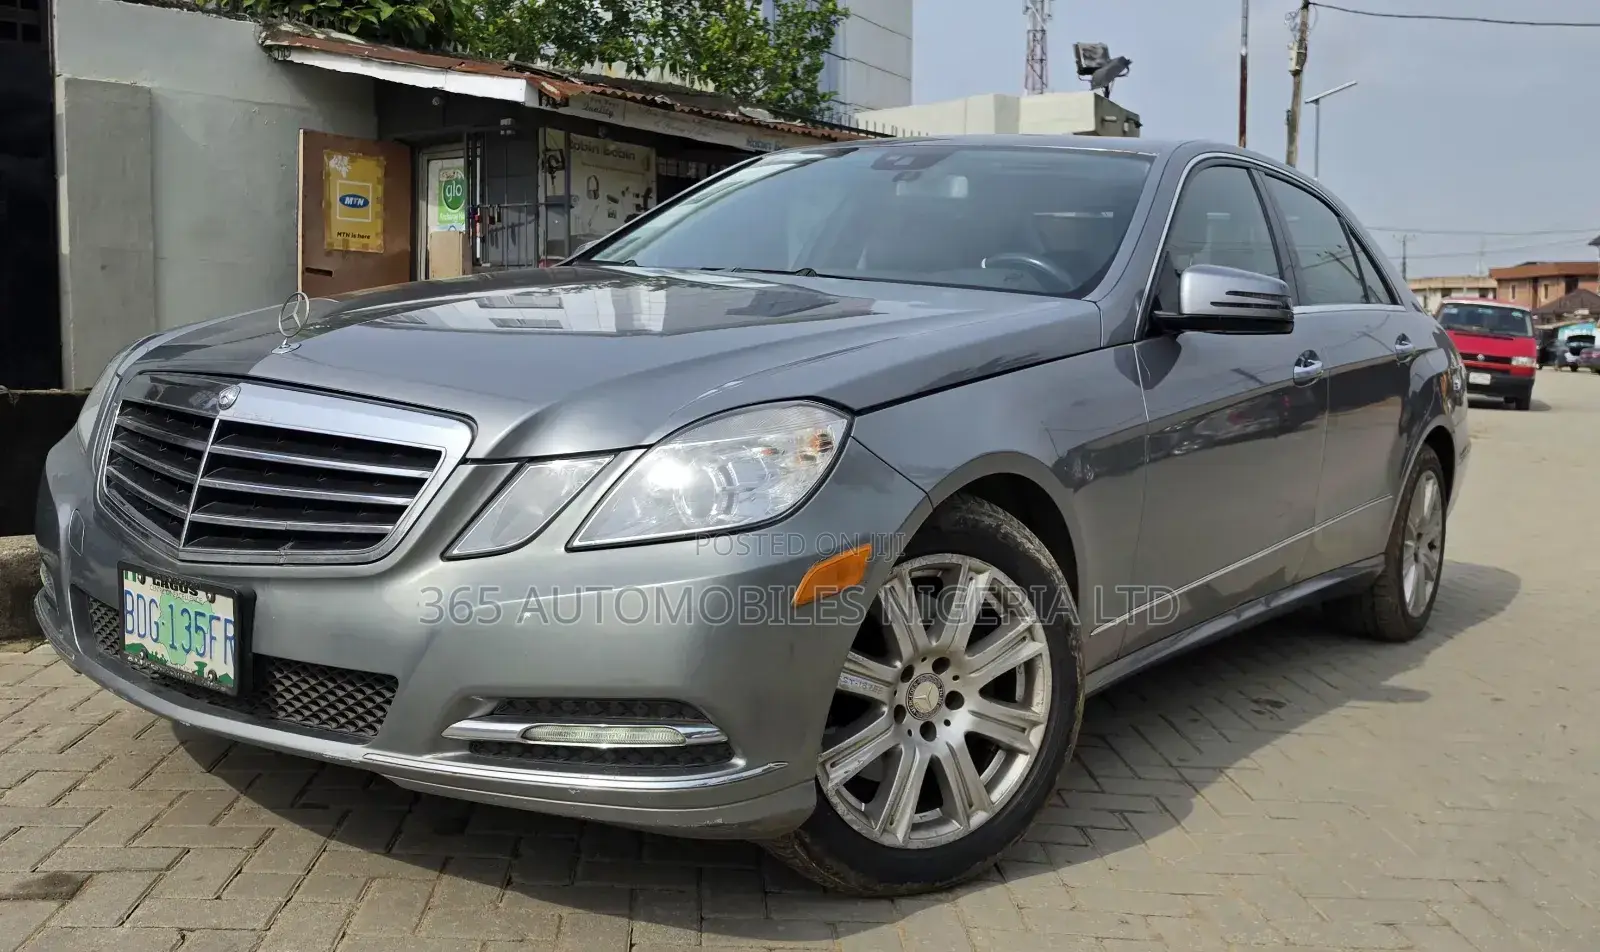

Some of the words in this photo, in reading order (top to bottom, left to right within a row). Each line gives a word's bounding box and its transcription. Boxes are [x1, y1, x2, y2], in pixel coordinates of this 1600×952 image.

[582, 101, 614, 119] Quality
[445, 180, 463, 203] glo
[344, 196, 365, 206] MTN
